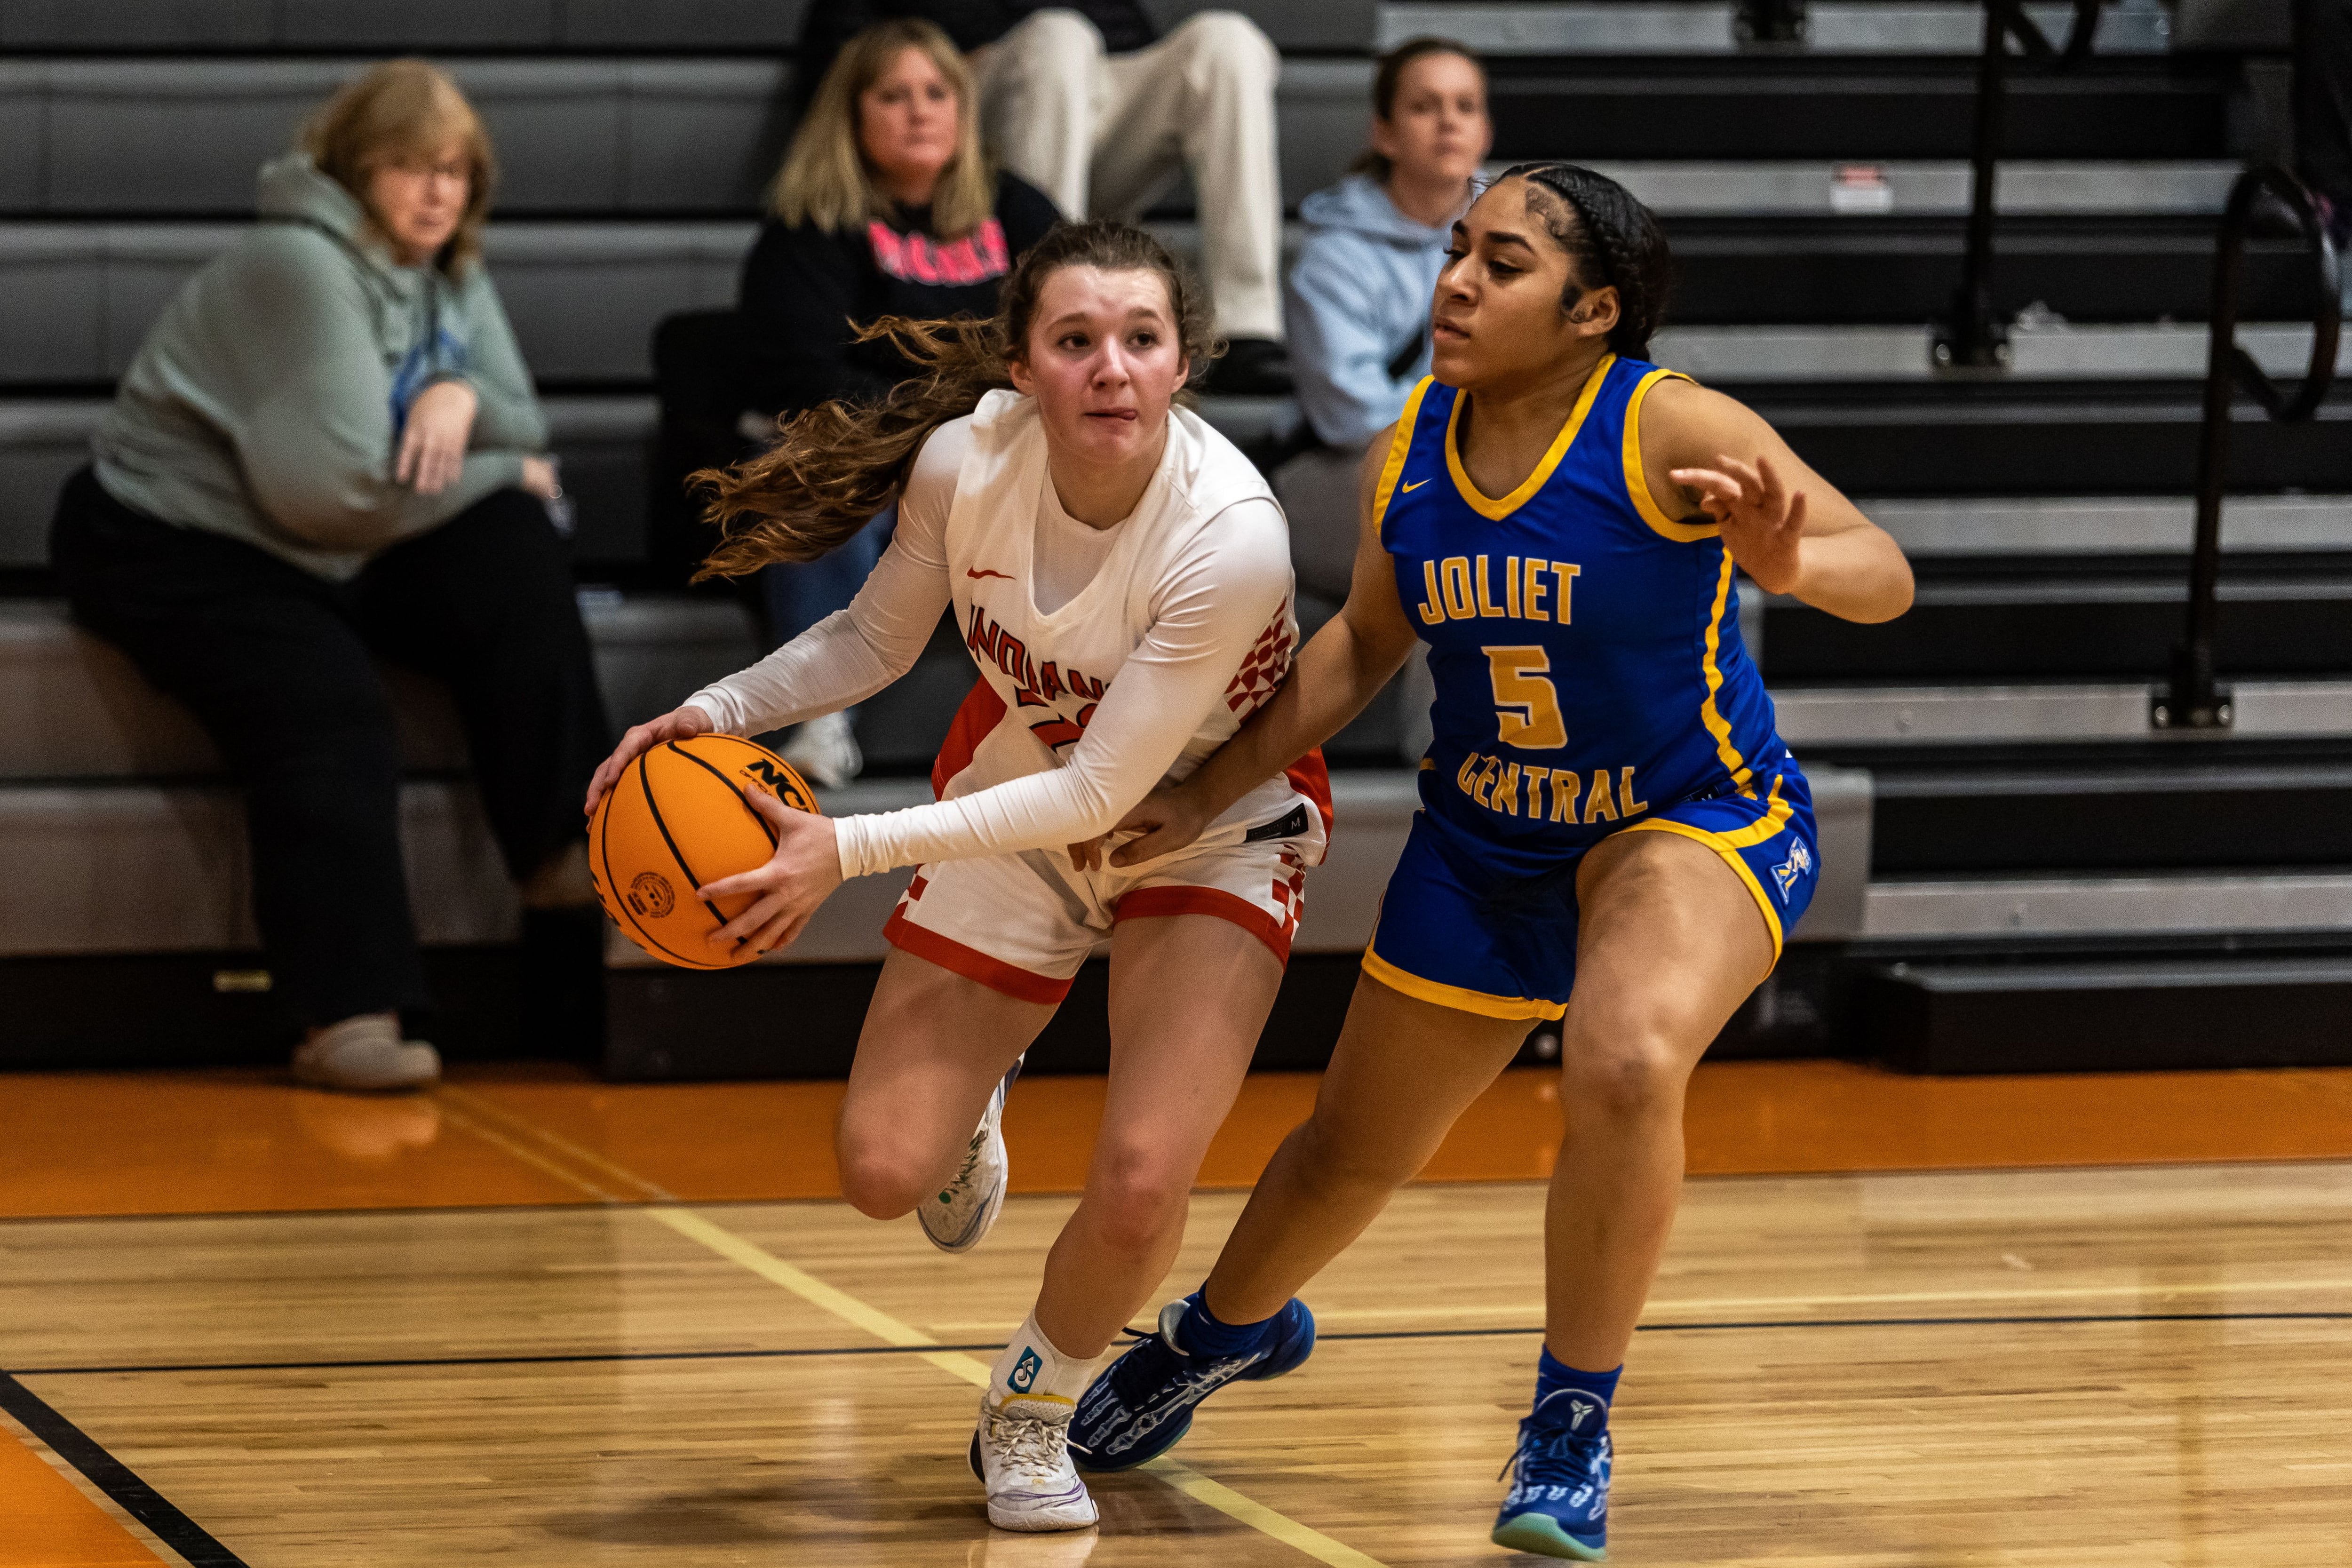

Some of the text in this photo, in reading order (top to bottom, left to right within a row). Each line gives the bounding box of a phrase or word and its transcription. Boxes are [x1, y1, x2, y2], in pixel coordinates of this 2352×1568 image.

[1418, 555, 1581, 625] JOLIET
[967, 599, 1111, 701] INDIAN
[1481, 645, 1568, 749] 5
[1291, 817, 1300, 830] M
[1457, 752, 1648, 824] CENTRAL
